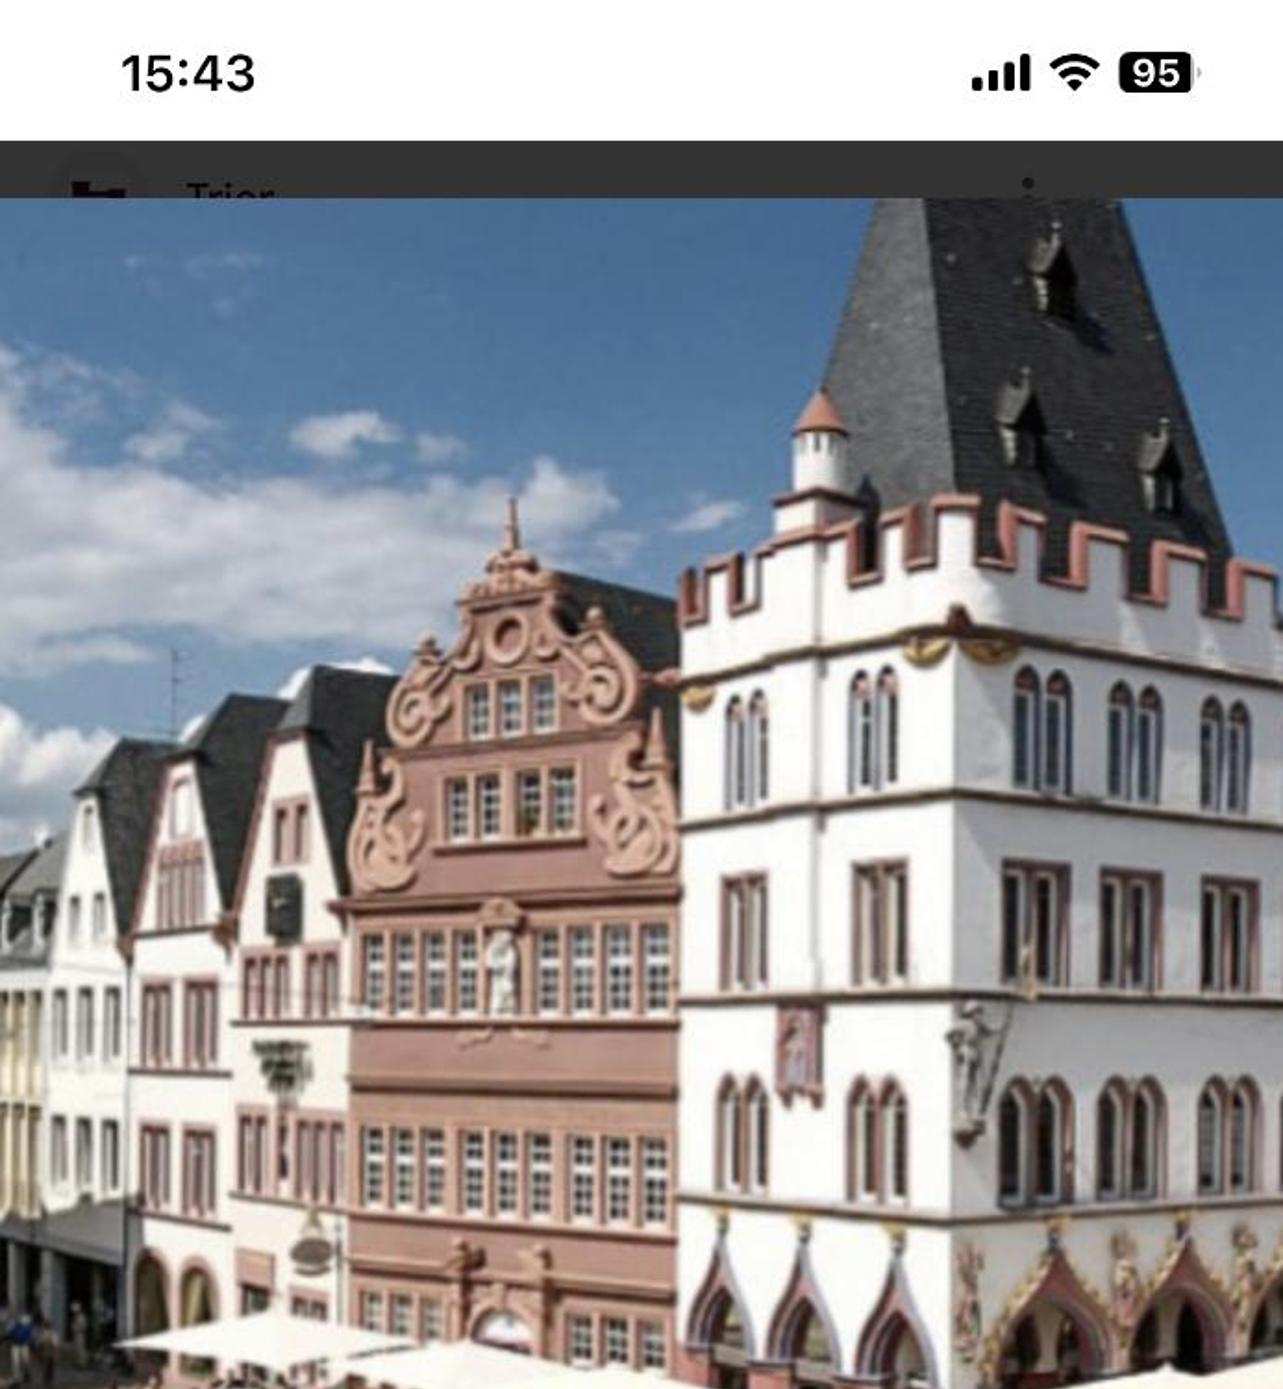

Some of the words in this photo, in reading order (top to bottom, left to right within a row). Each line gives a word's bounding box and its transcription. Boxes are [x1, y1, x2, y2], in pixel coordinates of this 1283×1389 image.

[121, 53, 256, 93] 15:43
[1131, 58, 1181, 88] 95
[185, 181, 277, 197] Trir
